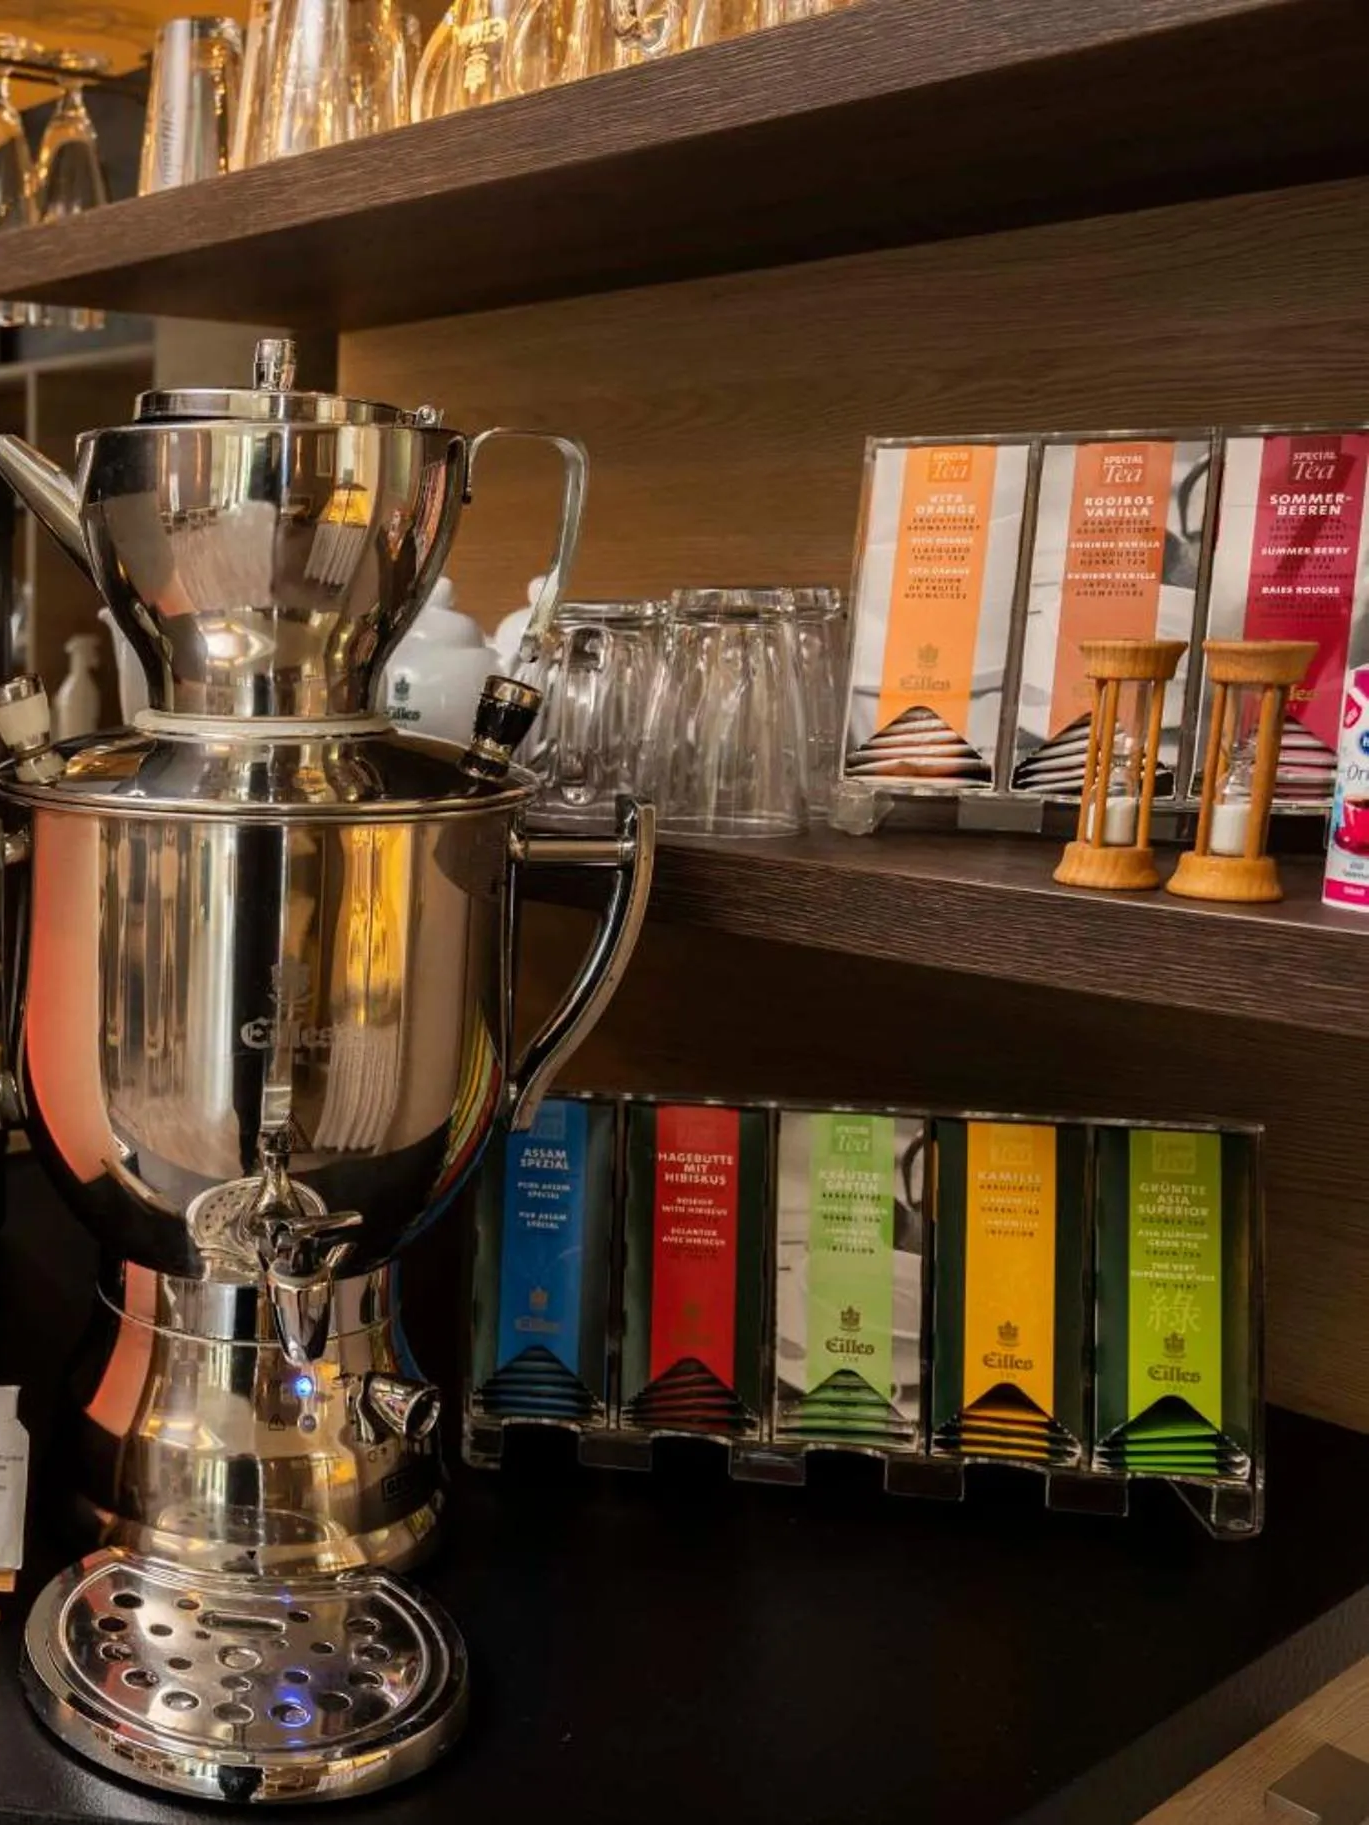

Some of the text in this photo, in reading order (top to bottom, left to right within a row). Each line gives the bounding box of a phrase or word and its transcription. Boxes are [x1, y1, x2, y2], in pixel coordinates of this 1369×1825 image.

[1103, 455, 1144, 465] SPECIAL
[1293, 452, 1339, 461] SPECIAL
[1103, 464, 1144, 483] Tea
[1292, 461, 1336, 481] Tea
[1084, 495, 1155, 507] ROOIBOS
[1269, 493, 1353, 505] SOMMER-
[914, 504, 976, 515] ORANGE
[1085, 507, 1150, 518] VANILLA
[1277, 504, 1342, 516] BEEREN
[1118, 540, 1161, 549] VANILLA
[1260, 546, 1351, 555] SUMMER BERRY
[1261, 586, 1341, 595] BAIES ROUGES
[523, 1148, 568, 1159] ASSAM
[657, 1152, 735, 1165] HAGEBUTTE
[520, 1158, 570, 1170] SPEZIAL
[683, 1163, 709, 1173] MIT
[664, 1172, 726, 1186] HIBISKUS
[977, 1171, 1042, 1184] KAMILLE
[1139, 1180, 1207, 1196] GRÜNTEE
[1156, 1194, 1192, 1206] ASIA
[1137, 1203, 1210, 1217] SUPERIOR
[824, 1337, 875, 1356] Eilles
[982, 1351, 1035, 1371] Eilles
[1146, 1363, 1202, 1384] Eilles
